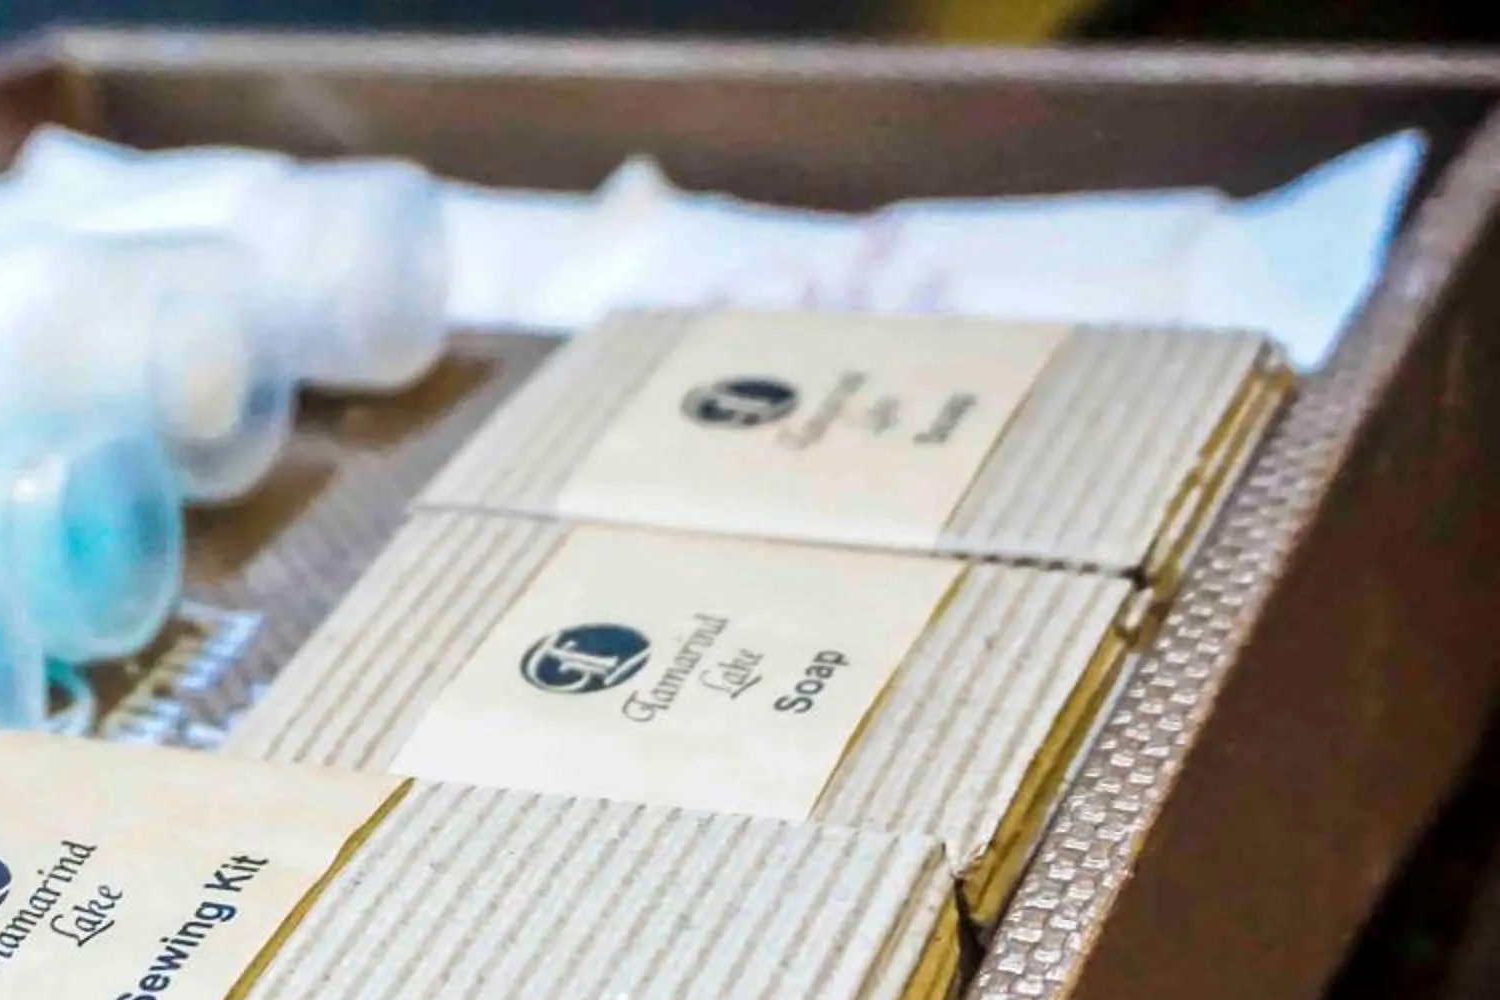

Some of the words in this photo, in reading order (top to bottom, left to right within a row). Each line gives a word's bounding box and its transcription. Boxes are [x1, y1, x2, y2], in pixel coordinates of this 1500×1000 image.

[622, 613, 729, 722] Tamarind
[701, 648, 764, 699] Lake
[773, 648, 850, 713] Soap
[204, 854, 269, 893] Kit
[50, 883, 123, 948] Lake
